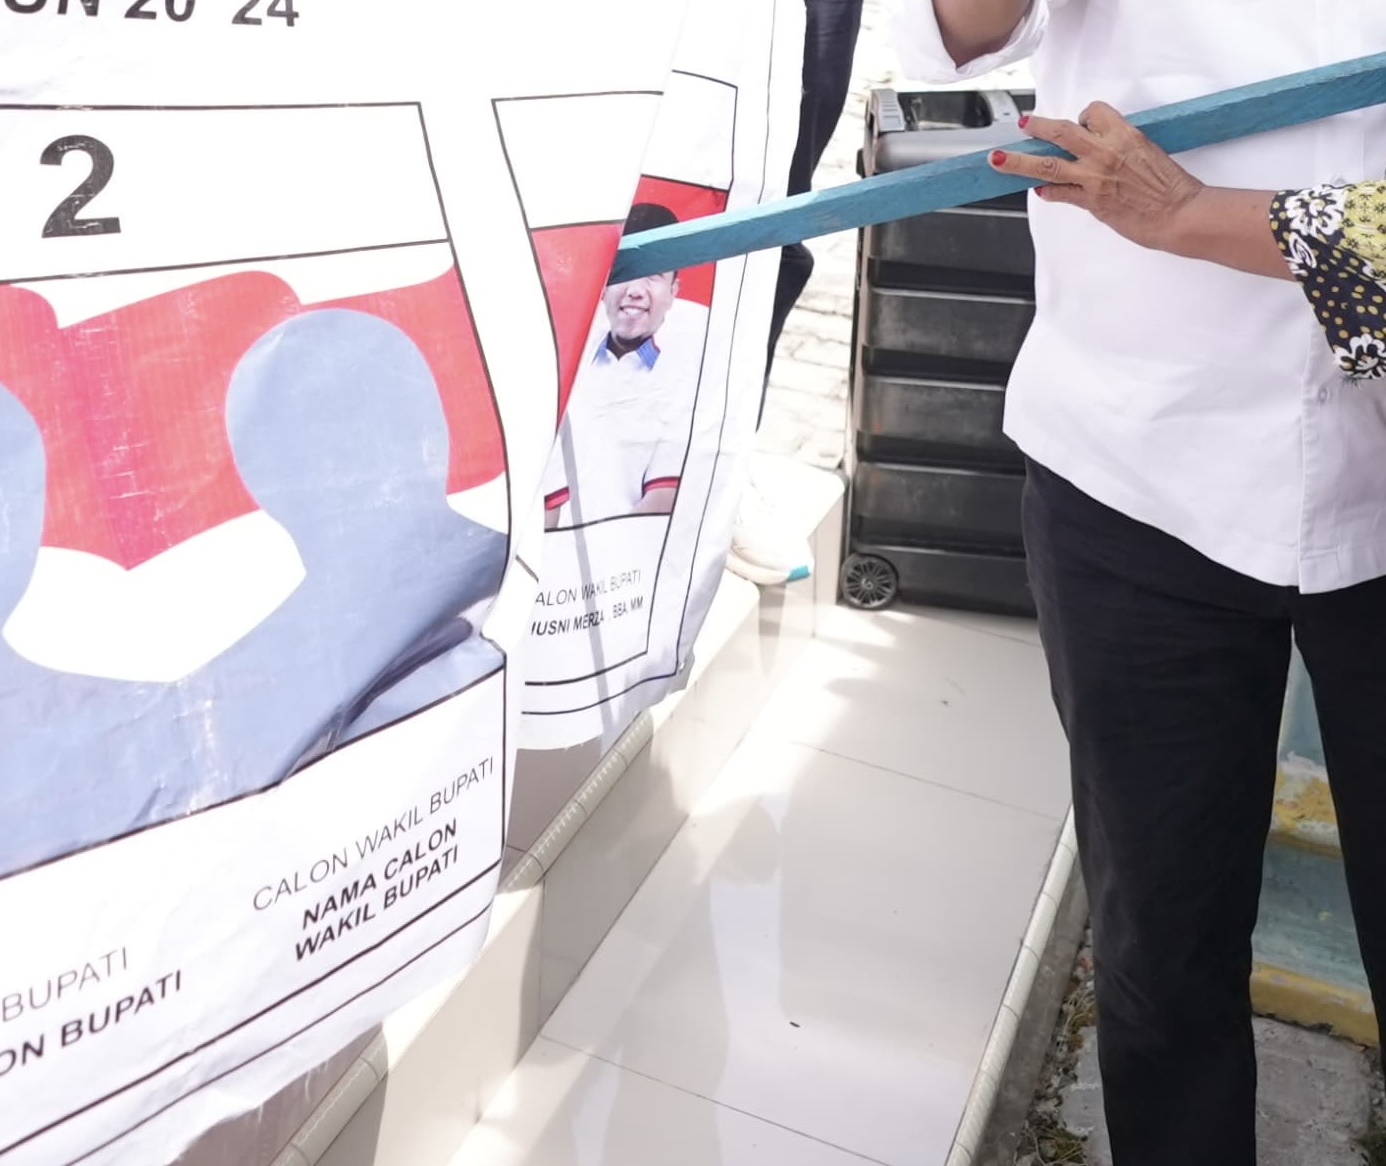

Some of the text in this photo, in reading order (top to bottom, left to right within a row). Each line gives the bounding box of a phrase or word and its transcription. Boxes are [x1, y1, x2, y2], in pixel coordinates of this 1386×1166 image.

[39, 133, 122, 239] 2
[534, 588, 578, 606] ALON
[253, 755, 494, 911] CALON WAKIL BUPATI
[302, 817, 458, 930] NAMA CALON
[295, 843, 459, 962] WAKIL BUPATI
[0, 946, 129, 1023] BUPATI
[60, 969, 183, 1049] BUPATI
